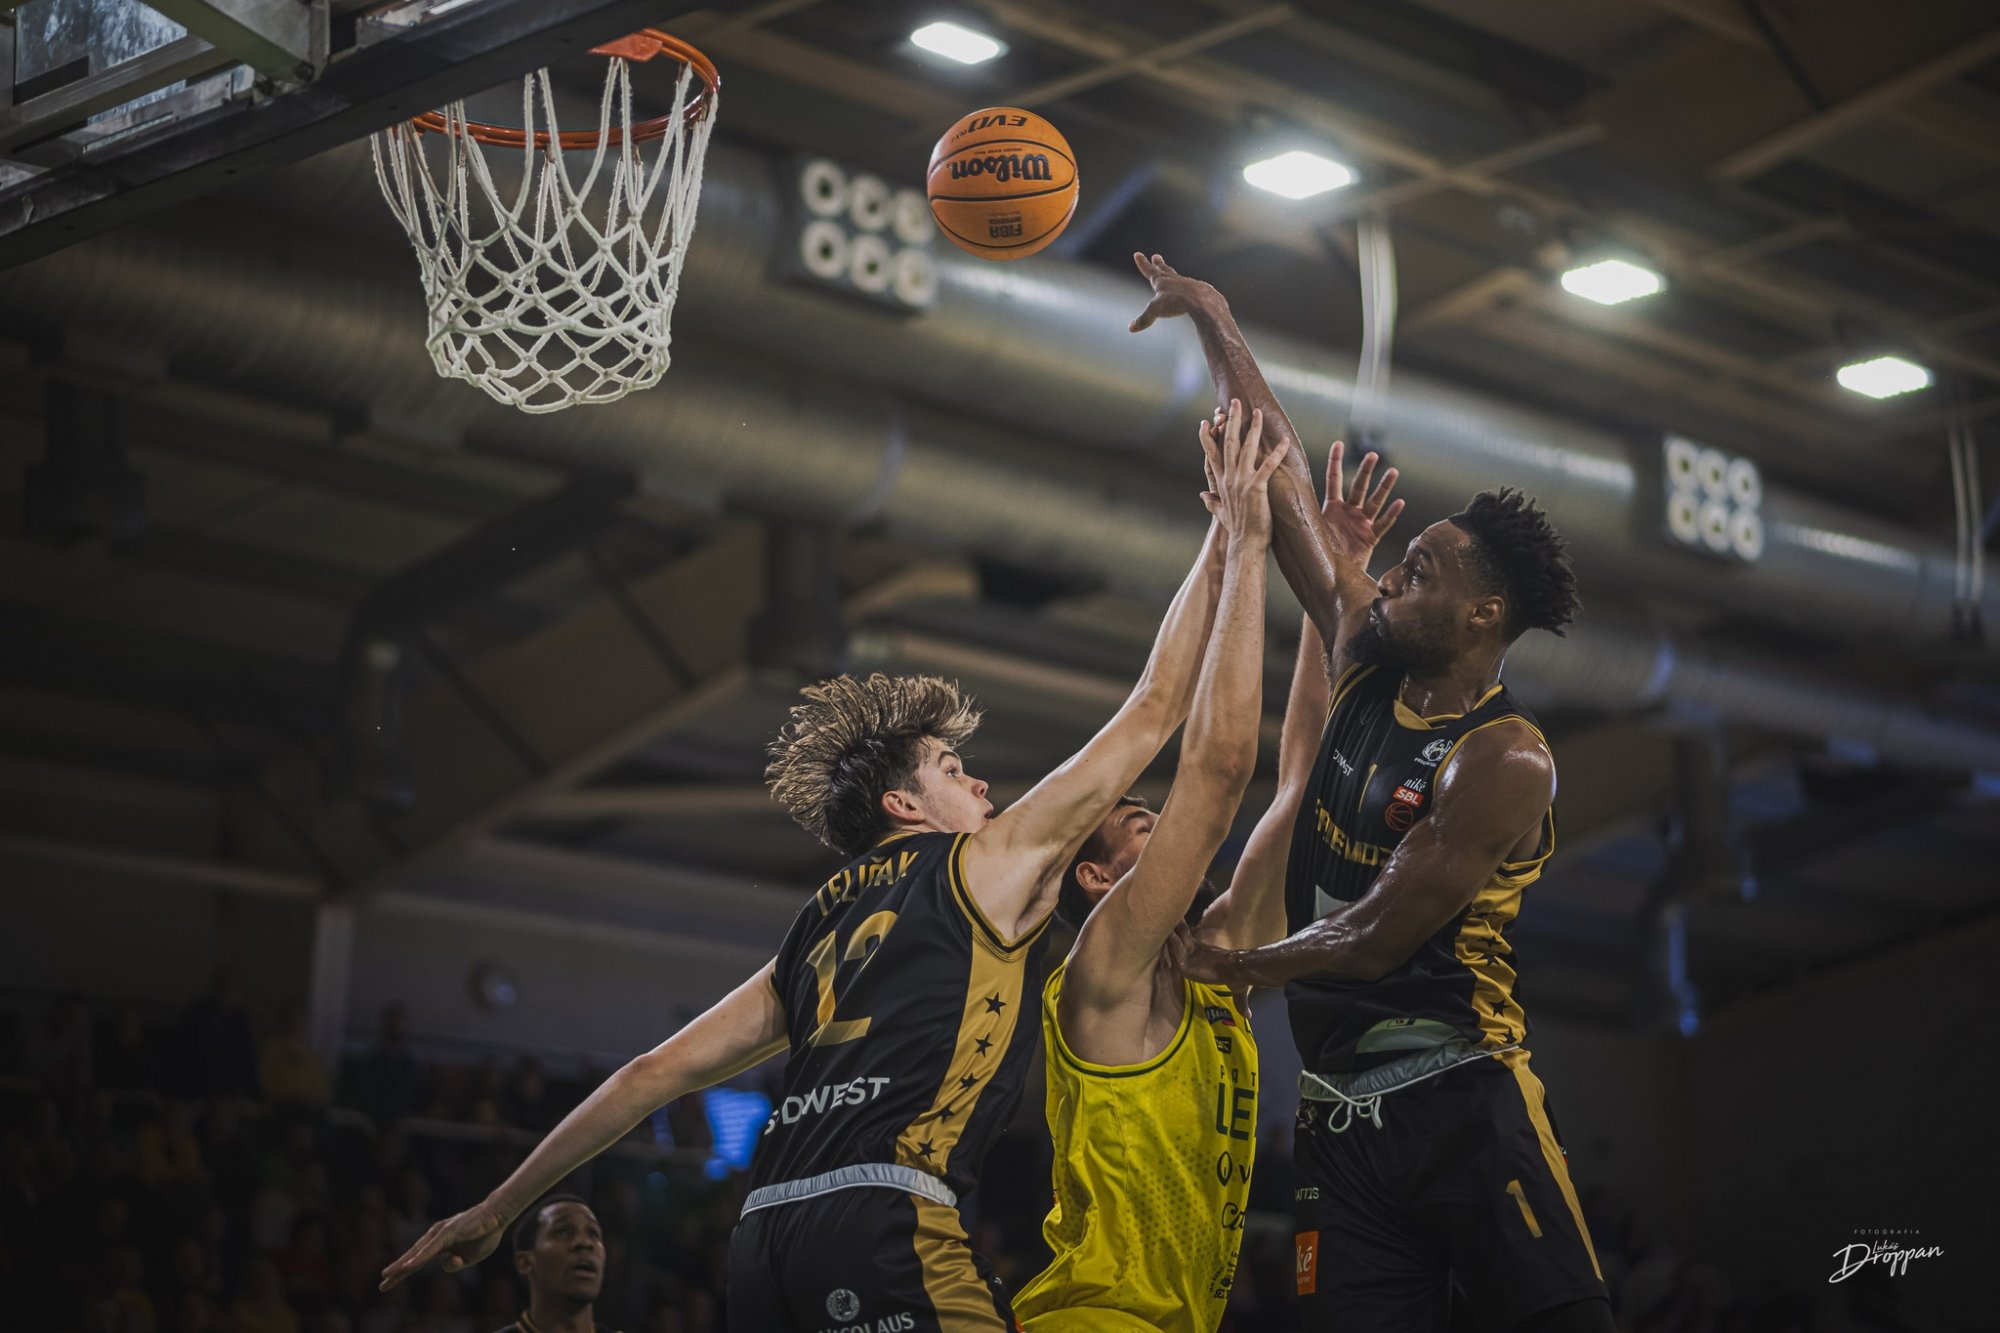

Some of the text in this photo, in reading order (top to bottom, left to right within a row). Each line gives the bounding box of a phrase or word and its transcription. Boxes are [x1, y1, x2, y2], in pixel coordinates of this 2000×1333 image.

[951, 154, 1052, 182] Wilson
[989, 224, 1022, 238] FIBA
[1396, 788, 1419, 806] SBL
[806, 910, 899, 1048] 12
[1505, 1179, 1543, 1239] 1
[817, 1311, 916, 1333] OLAUS
